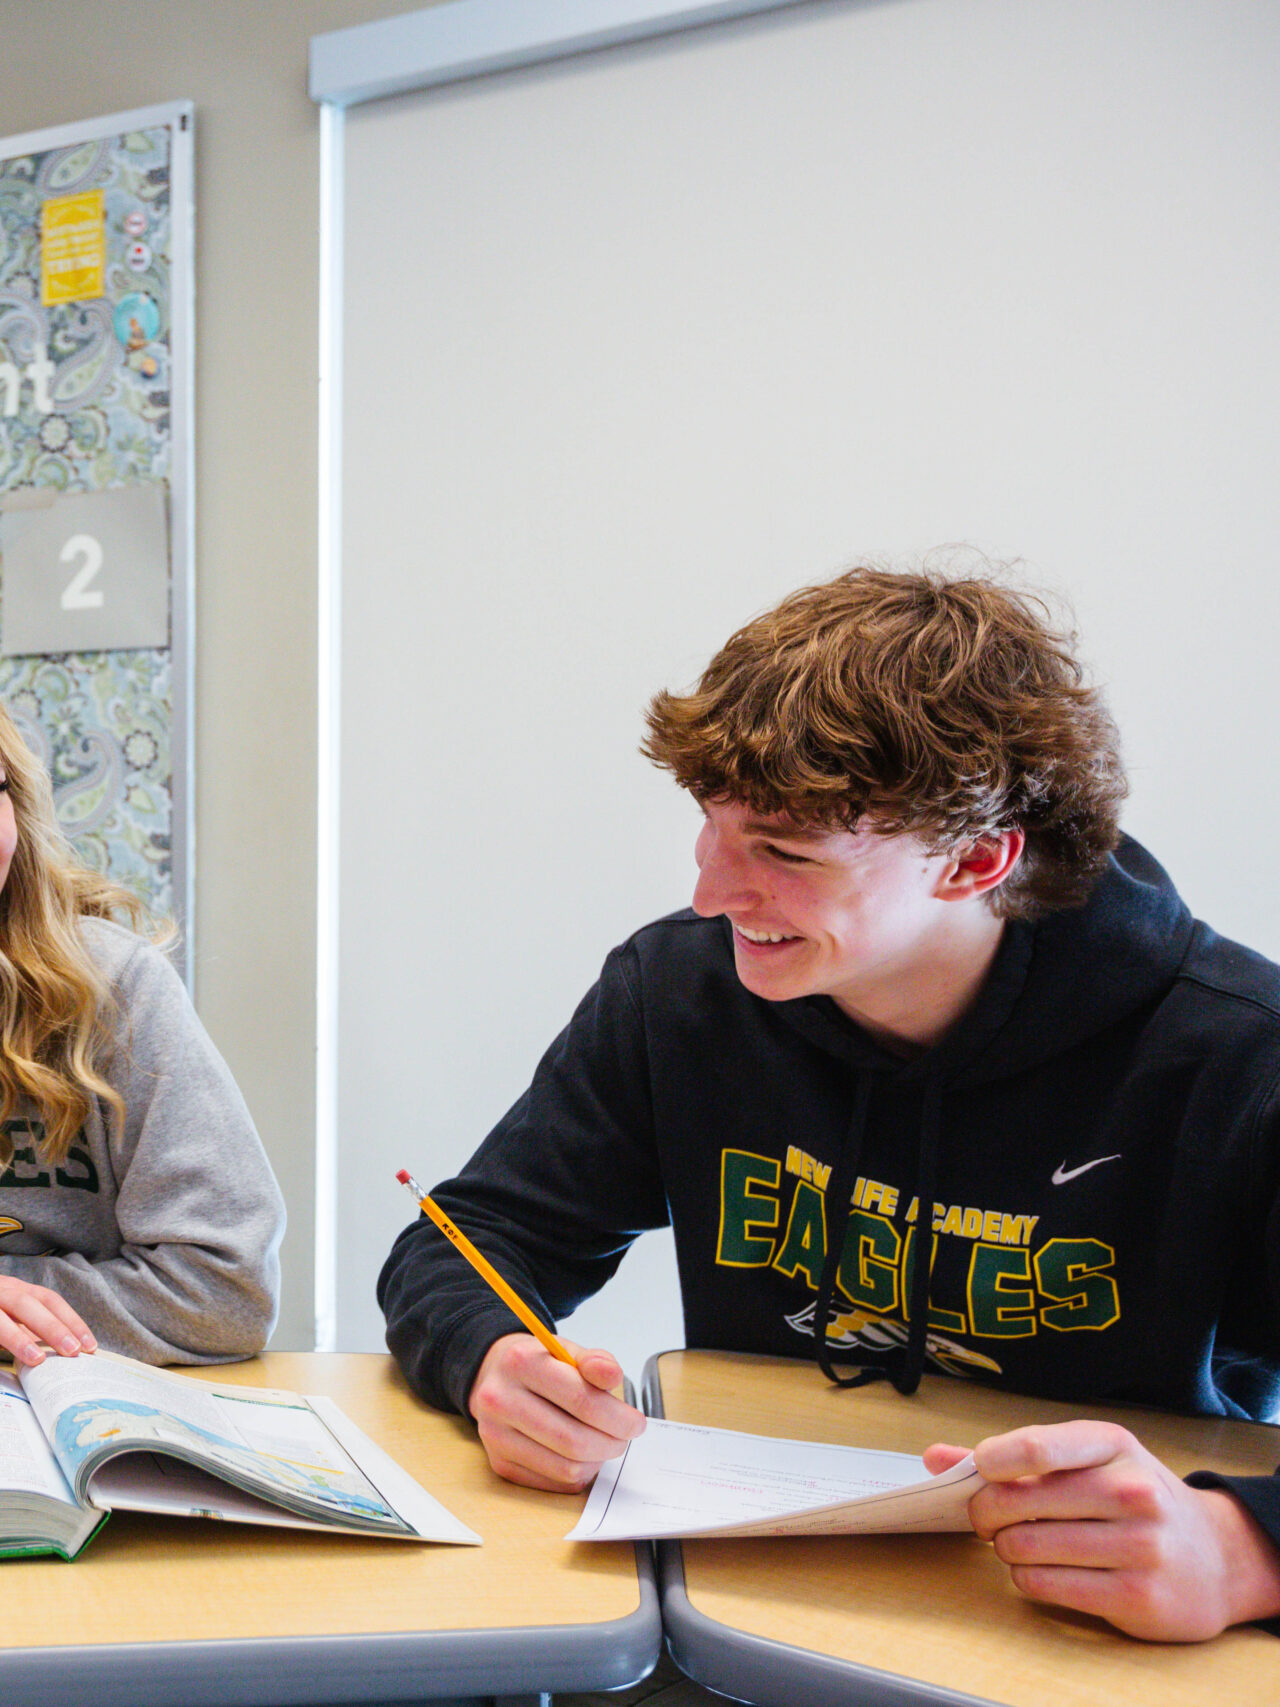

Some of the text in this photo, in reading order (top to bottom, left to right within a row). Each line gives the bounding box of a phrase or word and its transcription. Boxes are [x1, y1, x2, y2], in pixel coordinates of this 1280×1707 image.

[59, 534, 105, 611] 2
[785, 1144, 833, 1192] NEW
[849, 1176, 900, 1217] IFE
